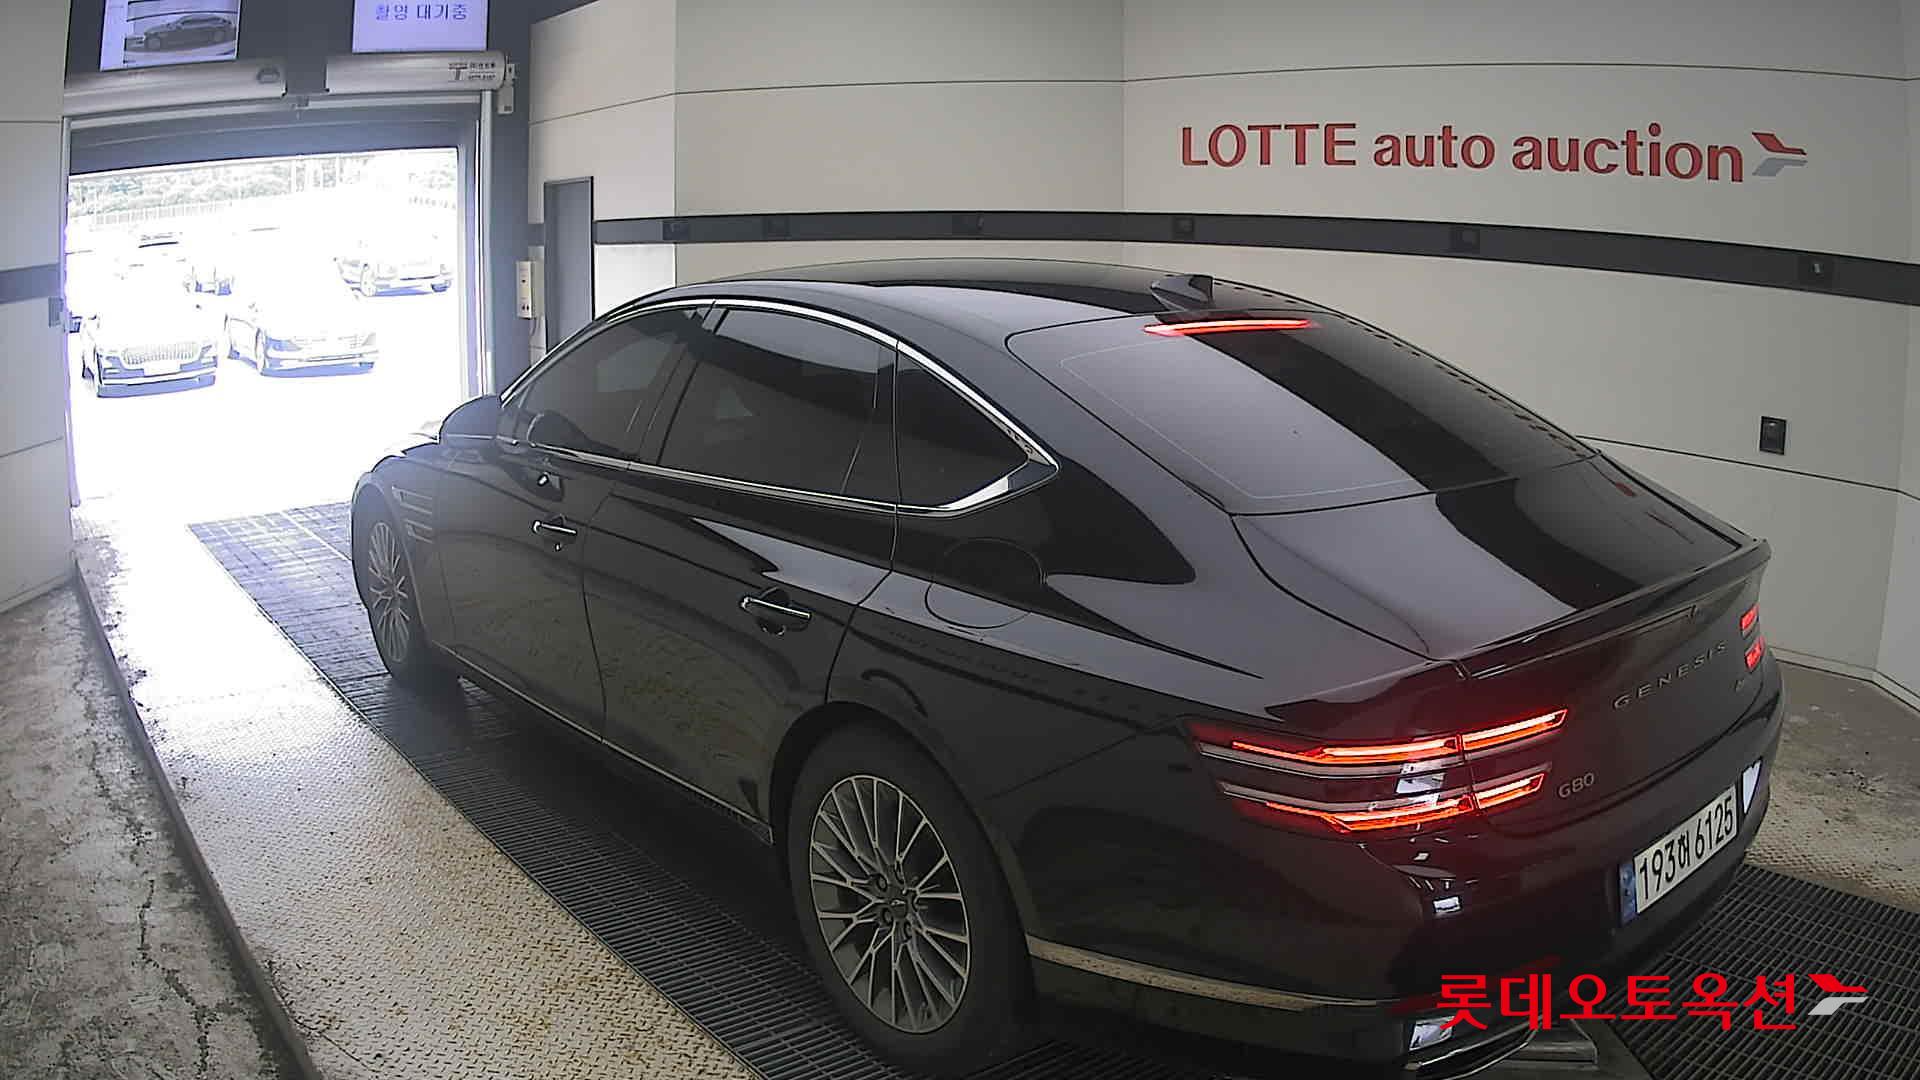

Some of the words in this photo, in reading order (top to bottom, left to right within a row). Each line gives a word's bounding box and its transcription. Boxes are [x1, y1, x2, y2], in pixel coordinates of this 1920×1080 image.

[416, 3, 467, 21] 대기중
[1181, 122, 1357, 167] LOTTE
[1373, 123, 1496, 169] auto
[1512, 122, 1744, 182] auction
[1612, 640, 1729, 710] GENESIS
[1558, 771, 1595, 798] G80
